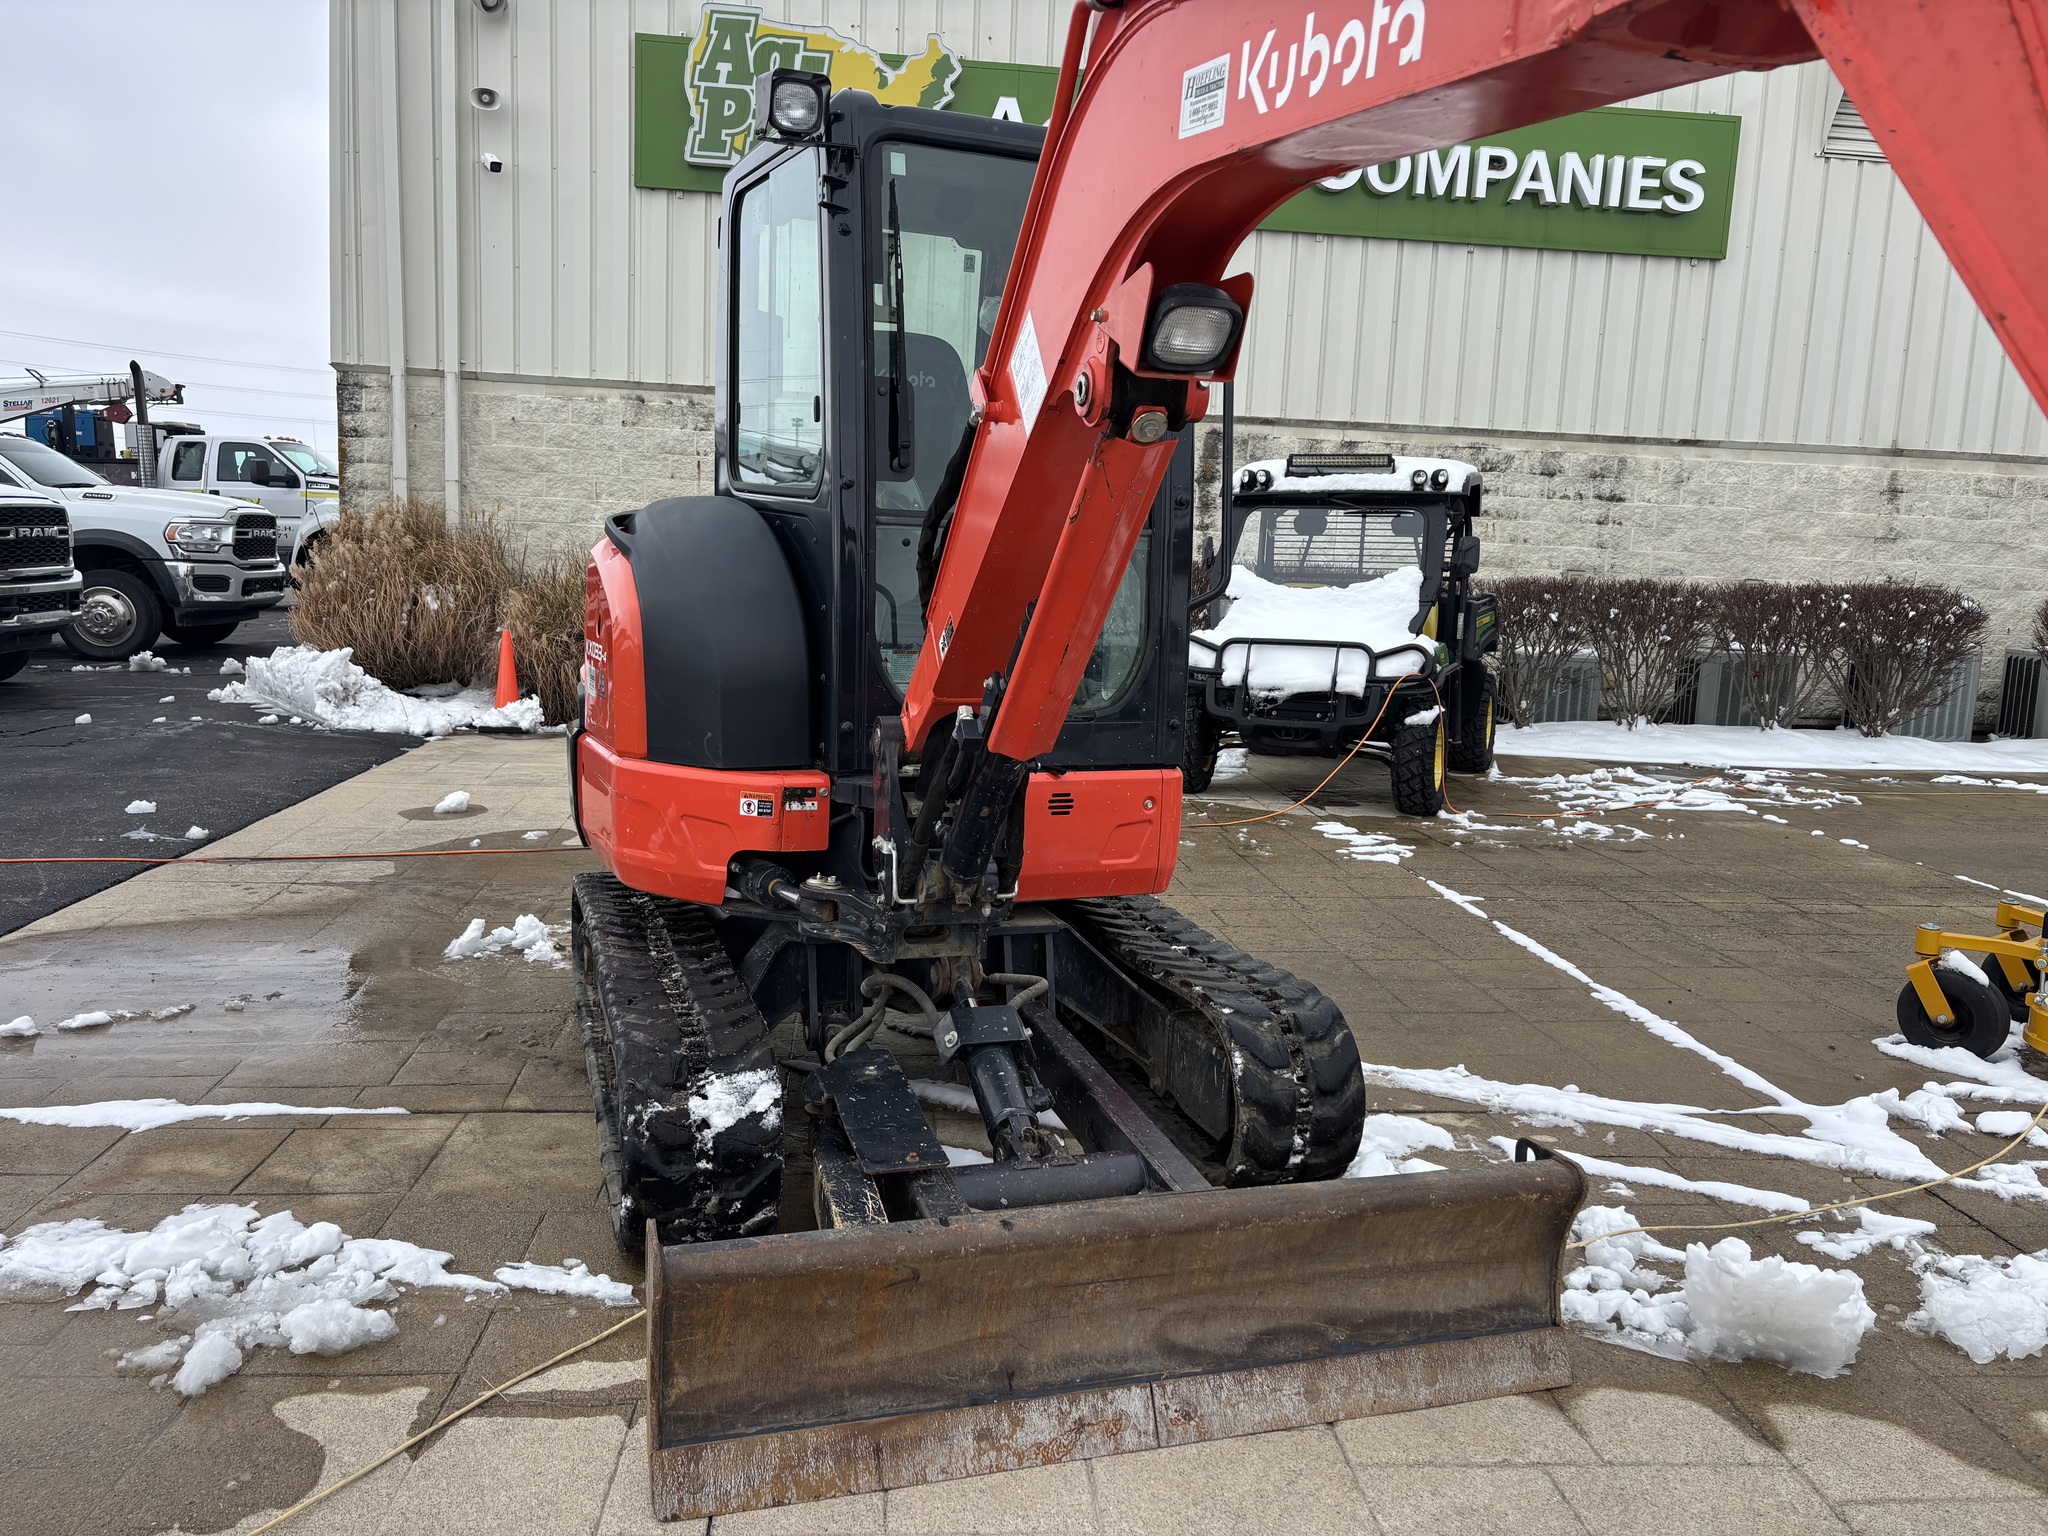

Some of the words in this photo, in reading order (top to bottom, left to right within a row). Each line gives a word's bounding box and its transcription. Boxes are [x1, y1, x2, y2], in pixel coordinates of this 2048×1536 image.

[1237, 0, 1426, 115] Kubota
[1184, 63, 1226, 100] HOEFLING
[18, 527, 57, 538] RAM
[253, 530, 274, 538] RAM
